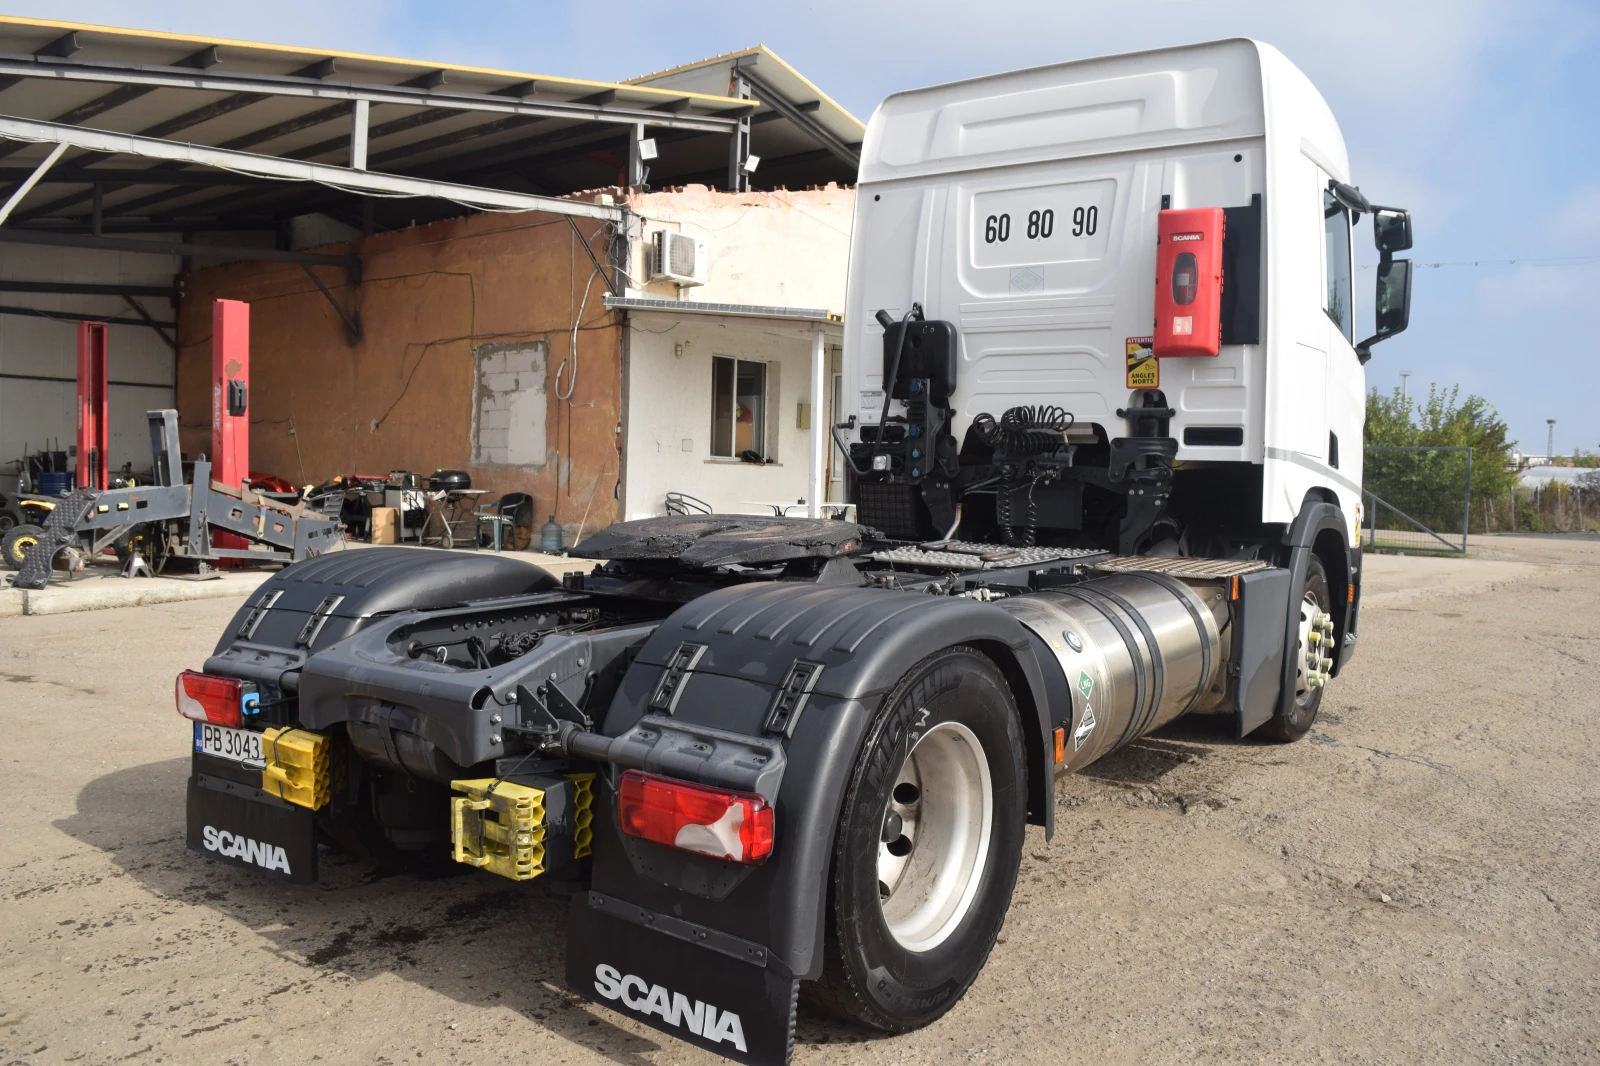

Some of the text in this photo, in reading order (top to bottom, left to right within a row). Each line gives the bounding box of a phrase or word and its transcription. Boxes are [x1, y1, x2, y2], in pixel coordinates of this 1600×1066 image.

[985, 213, 1011, 244] 60
[1027, 209, 1054, 239] 80
[1072, 205, 1098, 237] 90
[1172, 234, 1200, 242] SCANIA
[204, 725, 260, 761] PB 3043
[202, 825, 291, 874] SCANIA
[593, 963, 748, 1053] SCANIA
